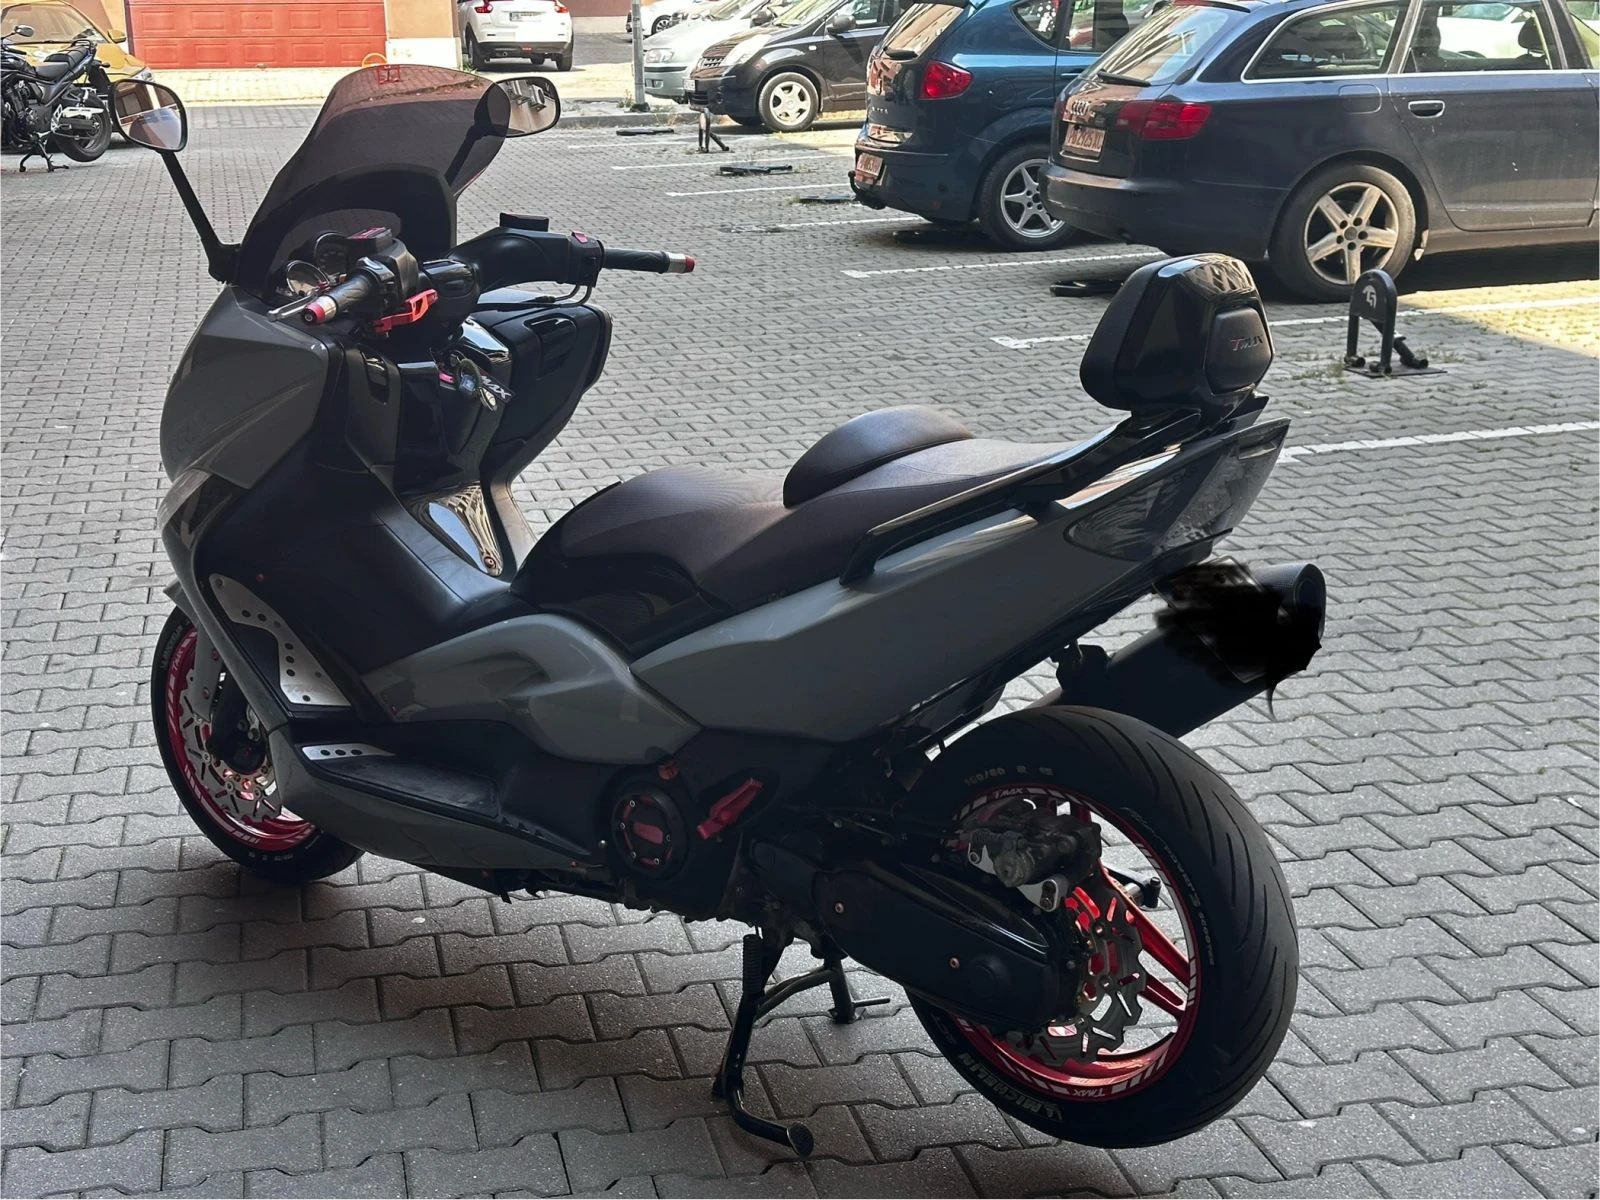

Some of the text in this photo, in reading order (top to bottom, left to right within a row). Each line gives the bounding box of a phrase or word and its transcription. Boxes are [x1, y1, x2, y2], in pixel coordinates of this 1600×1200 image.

[479, 367, 512, 399] MAX
[992, 788, 1023, 799] TMAX
[958, 1052, 1044, 1113] MICHELIN
[1072, 1087, 1106, 1097] TMAX
